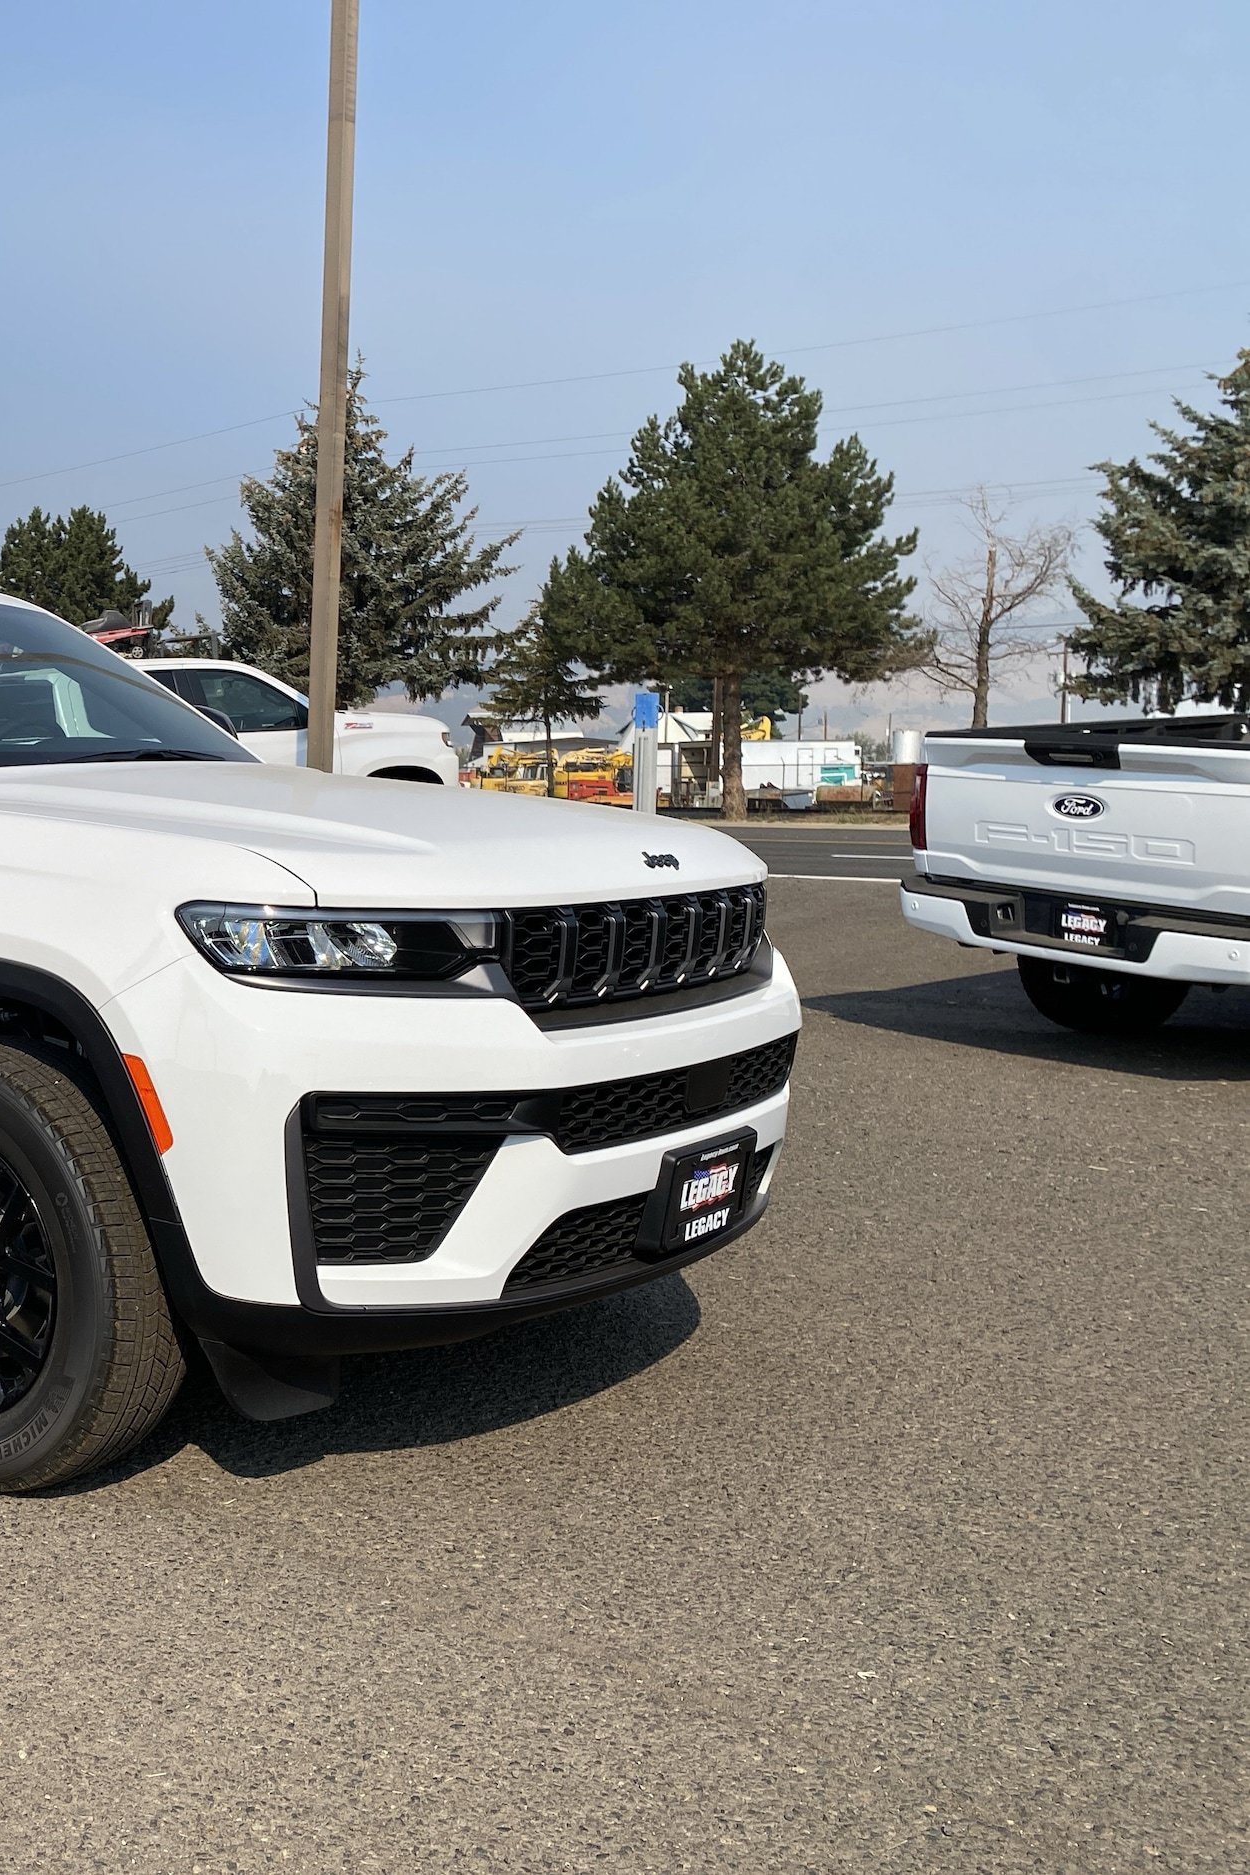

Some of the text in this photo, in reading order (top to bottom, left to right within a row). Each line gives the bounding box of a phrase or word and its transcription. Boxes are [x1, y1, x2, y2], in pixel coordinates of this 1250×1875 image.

[1060, 798, 1094, 817] Ford
[975, 820, 1195, 865] F-150
[641, 852, 680, 871] Jeep
[1061, 913, 1107, 933] LEGACY
[1064, 932, 1101, 946] LEGACY
[680, 1164, 740, 1211] LEGACY
[685, 1207, 731, 1242] LEGACY
